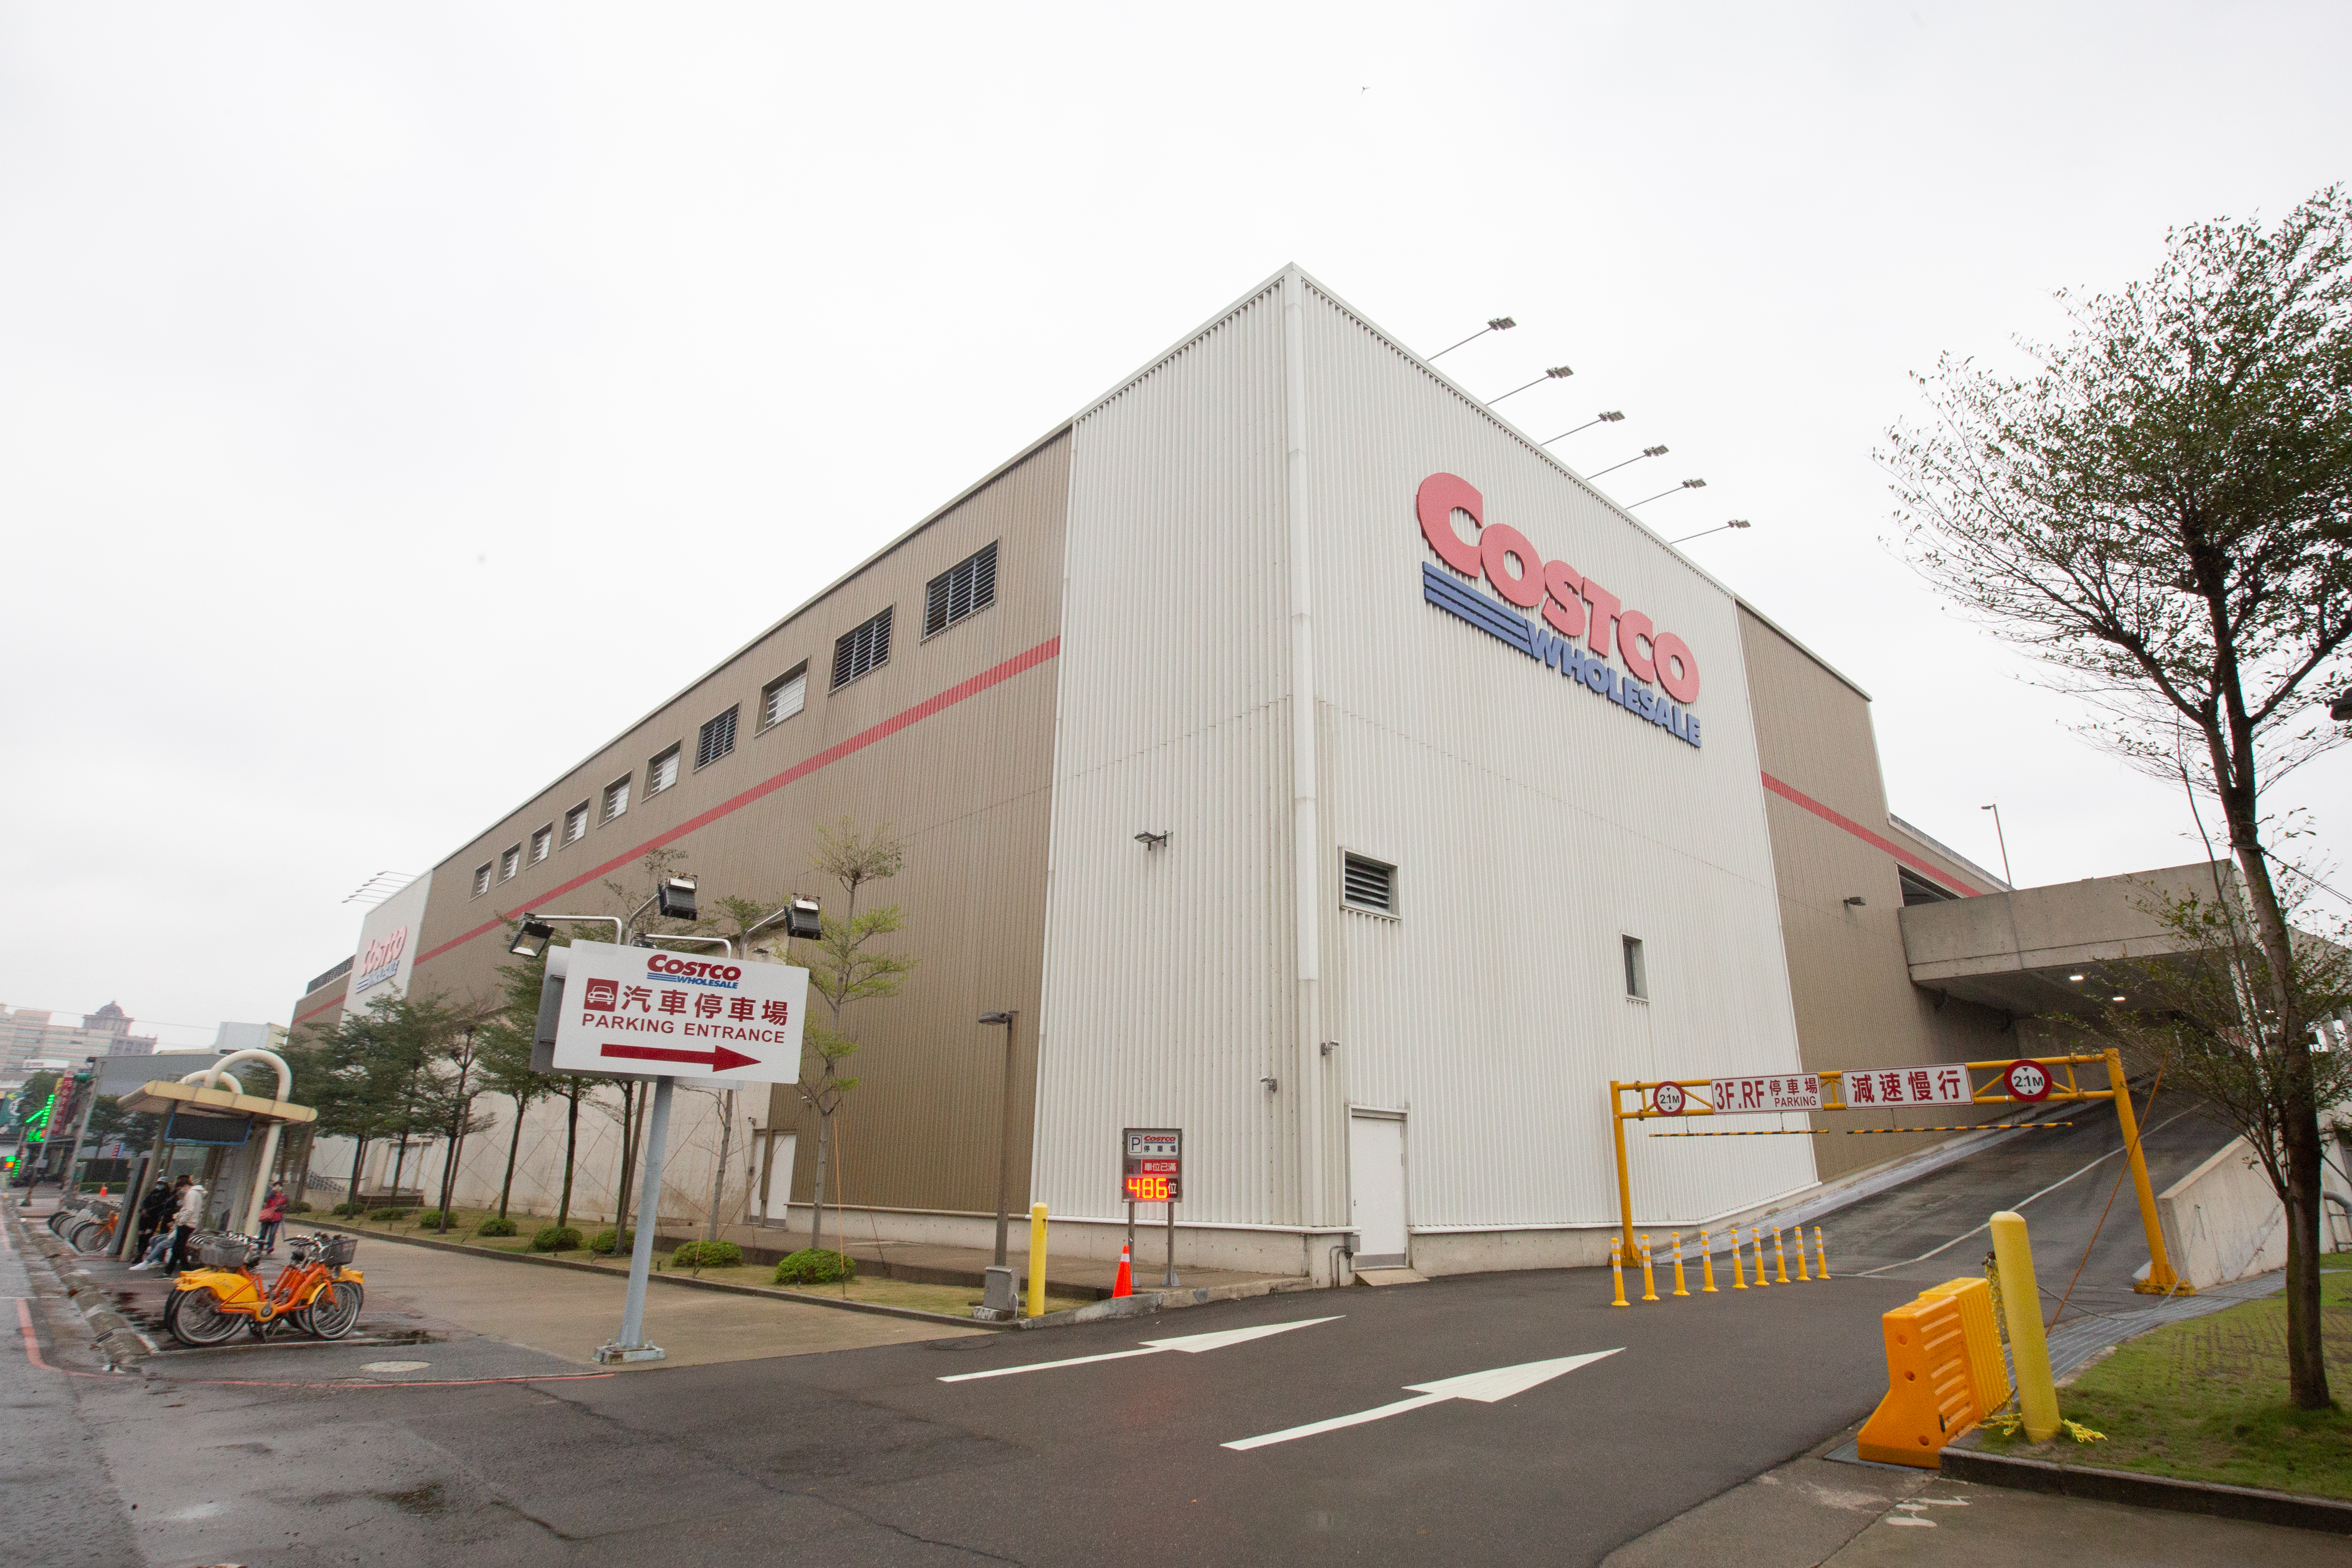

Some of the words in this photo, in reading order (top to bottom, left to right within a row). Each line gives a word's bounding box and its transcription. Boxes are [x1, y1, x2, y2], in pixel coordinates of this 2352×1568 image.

[1416, 472, 1700, 703] COSTCO
[1525, 619, 1701, 748] WHOLESALE
[647, 954, 741, 981] COSTCO
[677, 976, 739, 989] WHOLESALE
[621, 985, 788, 1026] 汽車停車場
[582, 1013, 674, 1033] PARKING
[684, 1022, 785, 1044] ENTRANCE
[1660, 1094, 1680, 1104] 2.1M
[1715, 1080, 1765, 1110] 3F.RF
[1769, 1078, 1818, 1096] 停車場
[1851, 1069, 1960, 1103] 減速慢行
[1775, 1096, 1817, 1107] PARKING
[1131, 1137, 1140, 1151] P
[1128, 1178, 1168, 1198] 486
[1168, 1182, 1177, 1194] 位
